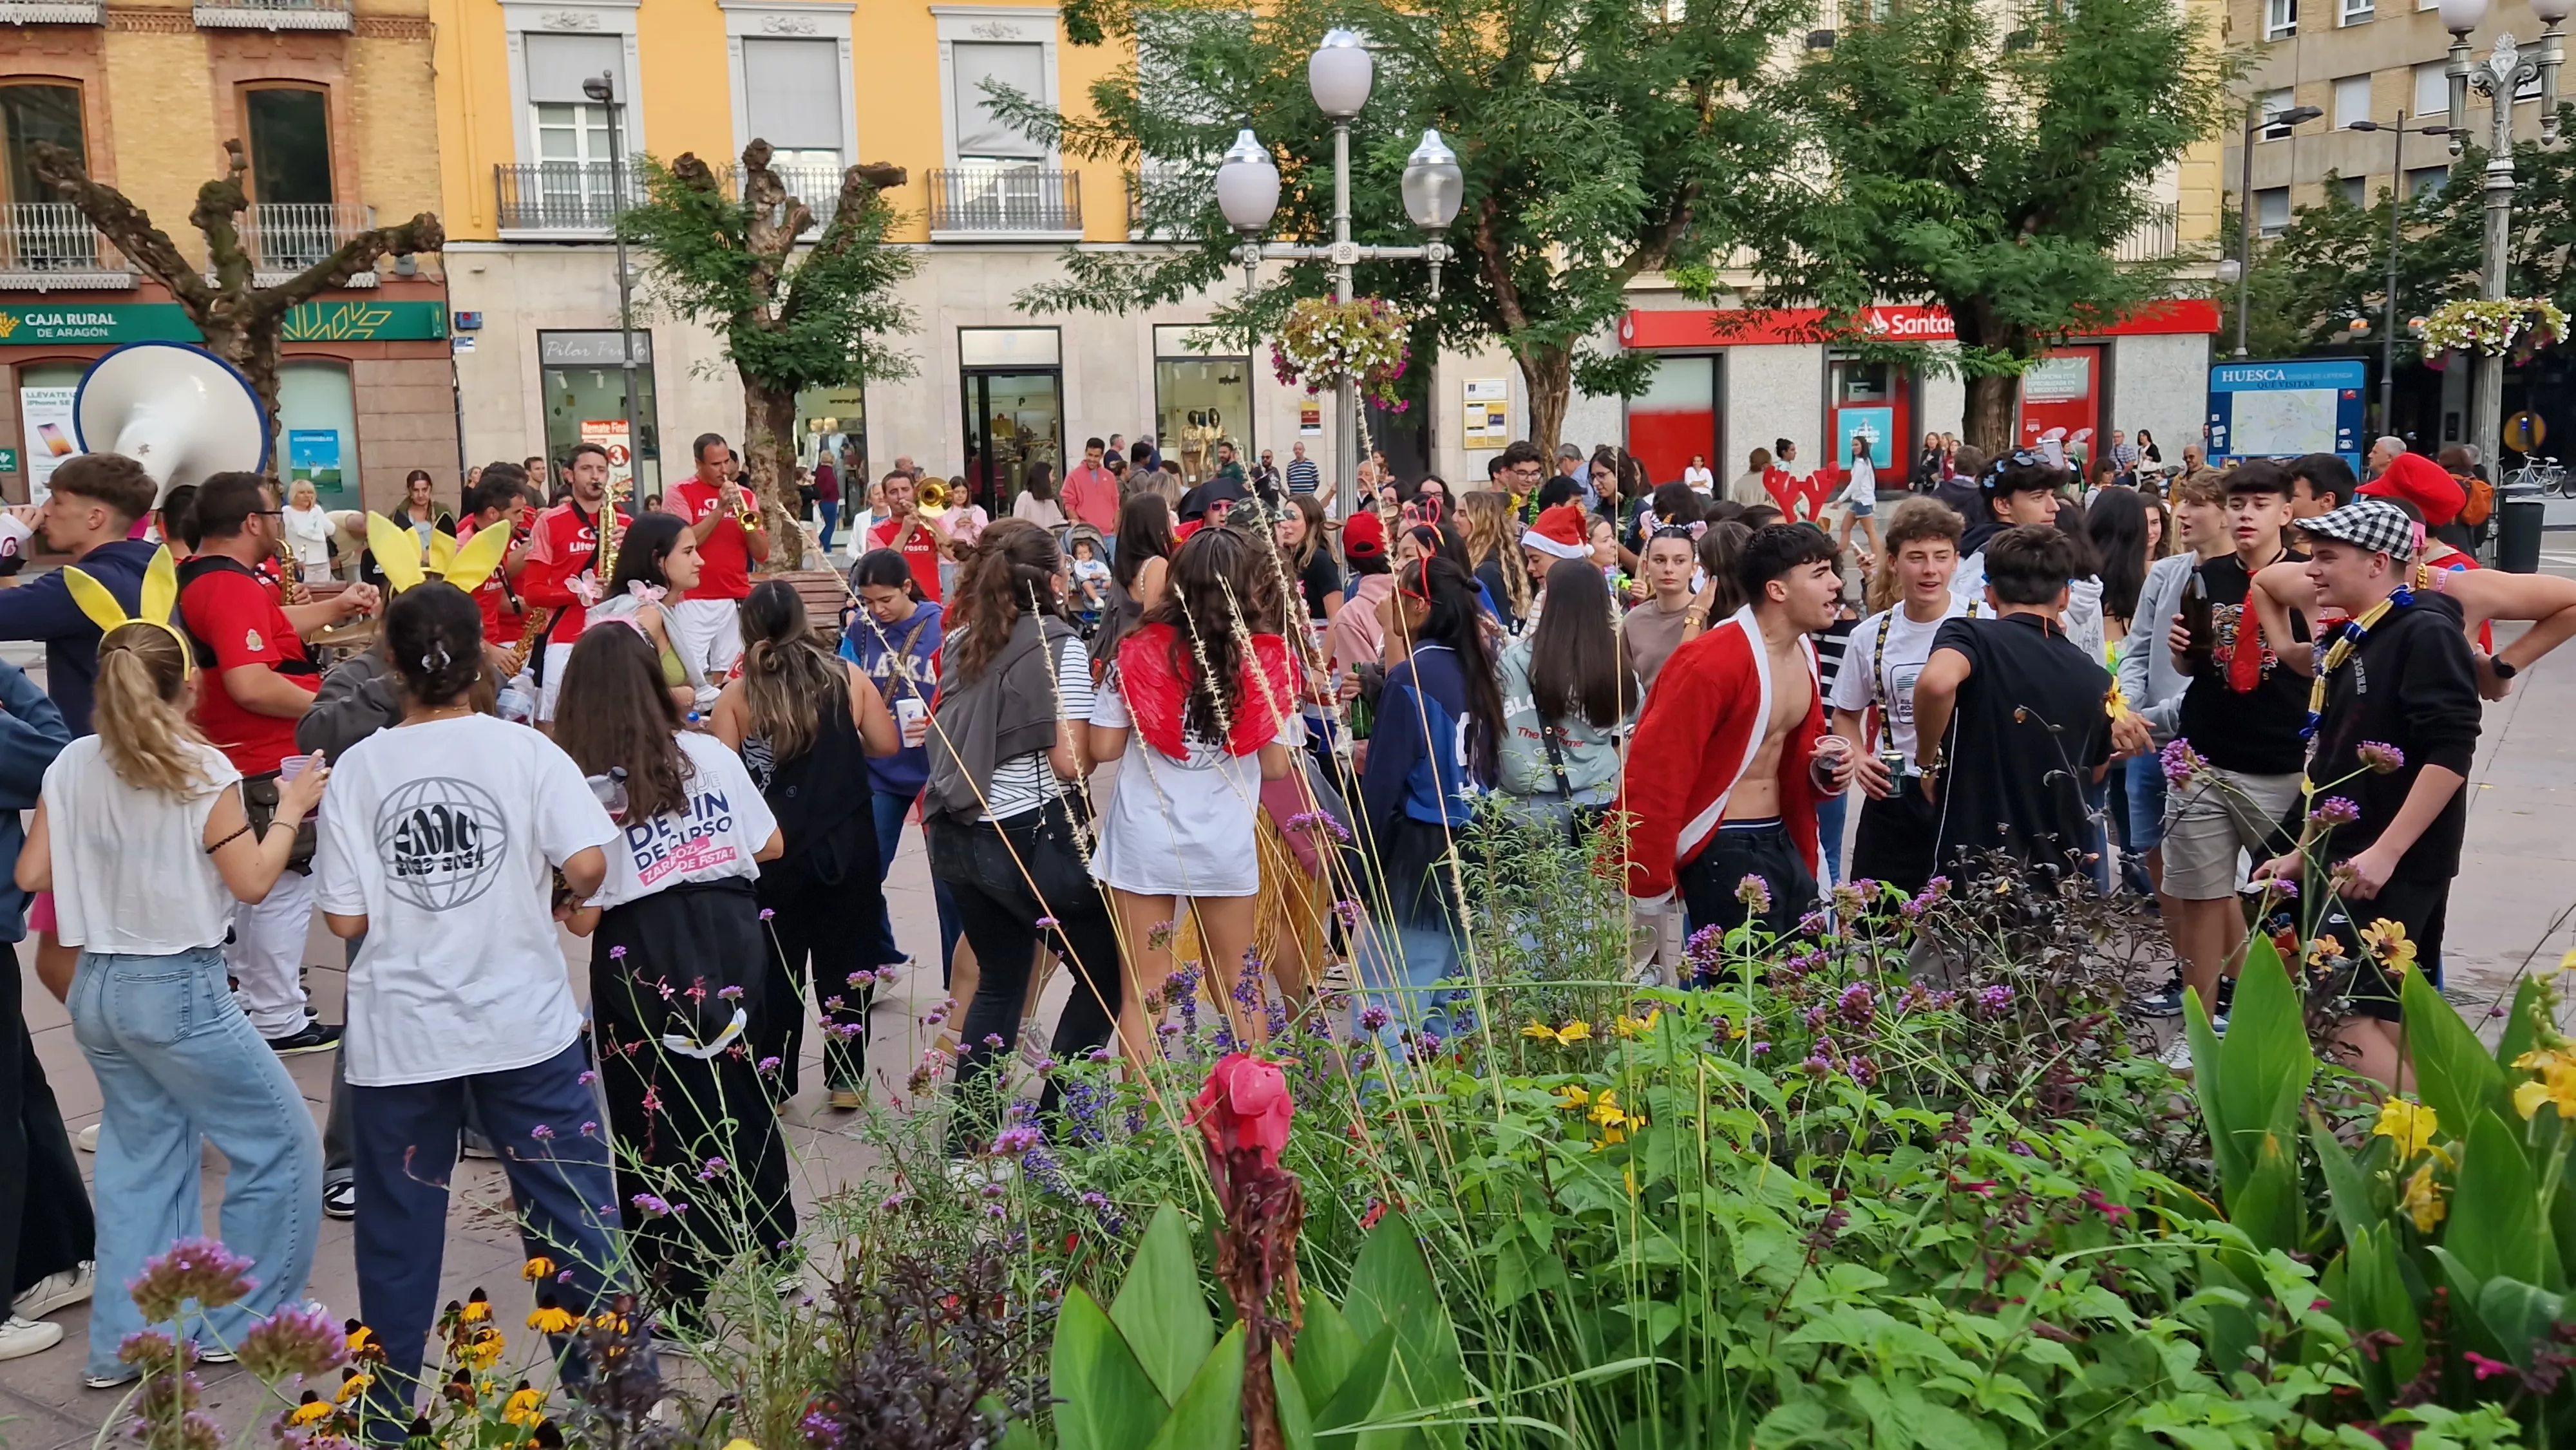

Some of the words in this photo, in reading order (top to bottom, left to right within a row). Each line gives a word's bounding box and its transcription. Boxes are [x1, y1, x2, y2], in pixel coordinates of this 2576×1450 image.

[24, 313, 64, 326] CAJA
[66, 313, 117, 325] RURAL
[37, 328, 53, 338] DE
[56, 326, 108, 337] ARAGÓN
[546, 340, 590, 357] Pilar
[2222, 369, 2286, 382] HUESCA
[2278, 380, 2315, 389] VISITAR
[582, 422, 611, 433] Remate
[611, 421, 629, 433] Final
[569, 541, 596, 553] Liter
[1517, 726, 1540, 739] The
[625, 814, 671, 853] DE
[634, 842, 667, 871] DE
[678, 860, 695, 870] DE
